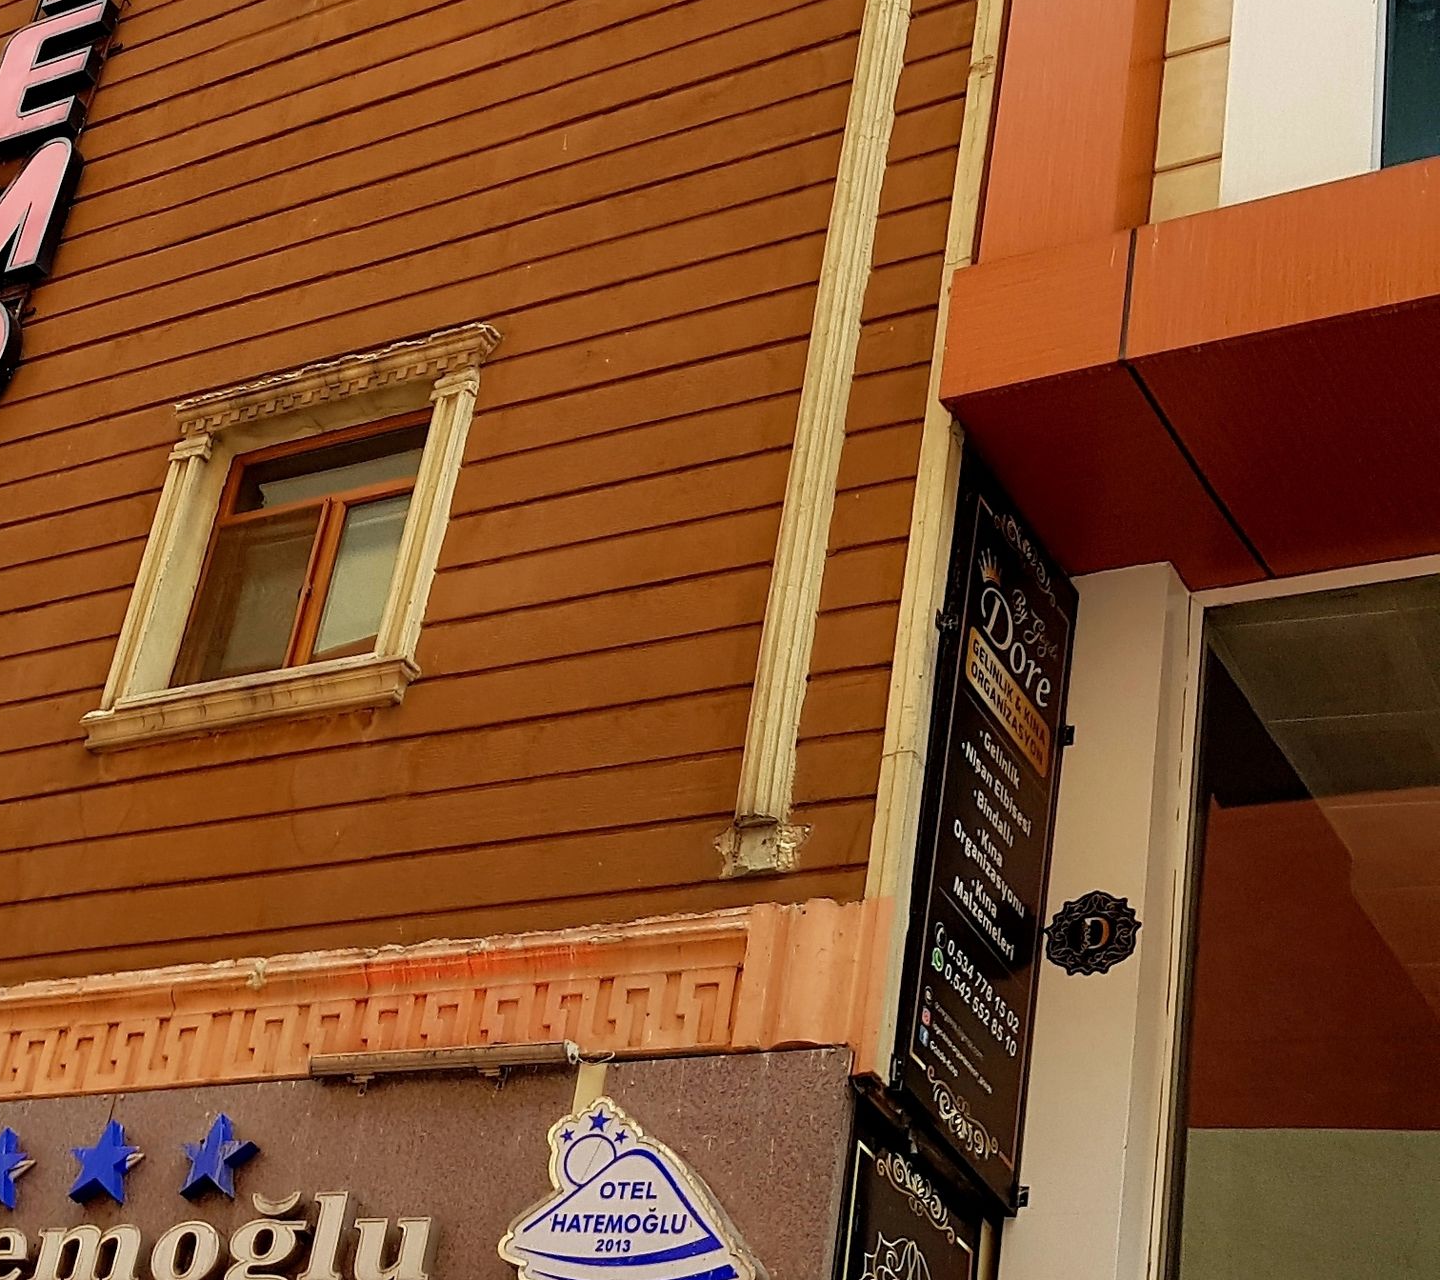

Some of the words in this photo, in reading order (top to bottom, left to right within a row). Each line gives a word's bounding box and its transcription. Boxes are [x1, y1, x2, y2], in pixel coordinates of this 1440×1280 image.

[980, 586, 1051, 708] Dore
[953, 819, 1025, 919] Organizasyonu
[953, 875, 1015, 962] Malzemeleri
[944, 963, 972, 1004] 0.542
[971, 996, 991, 1026] 552
[990, 1018, 1003, 1041] 85
[1004, 1035, 1017, 1057] 10
[947, 939, 974, 979] 0.534
[974, 972, 993, 1002] 778
[994, 996, 1007, 1018] 15
[1006, 1010, 1020, 1034] 02
[550, 1207, 687, 1235] HATEMOĞLU
[599, 1181, 657, 1200] OTEL
[595, 1239, 631, 1253] 2013
